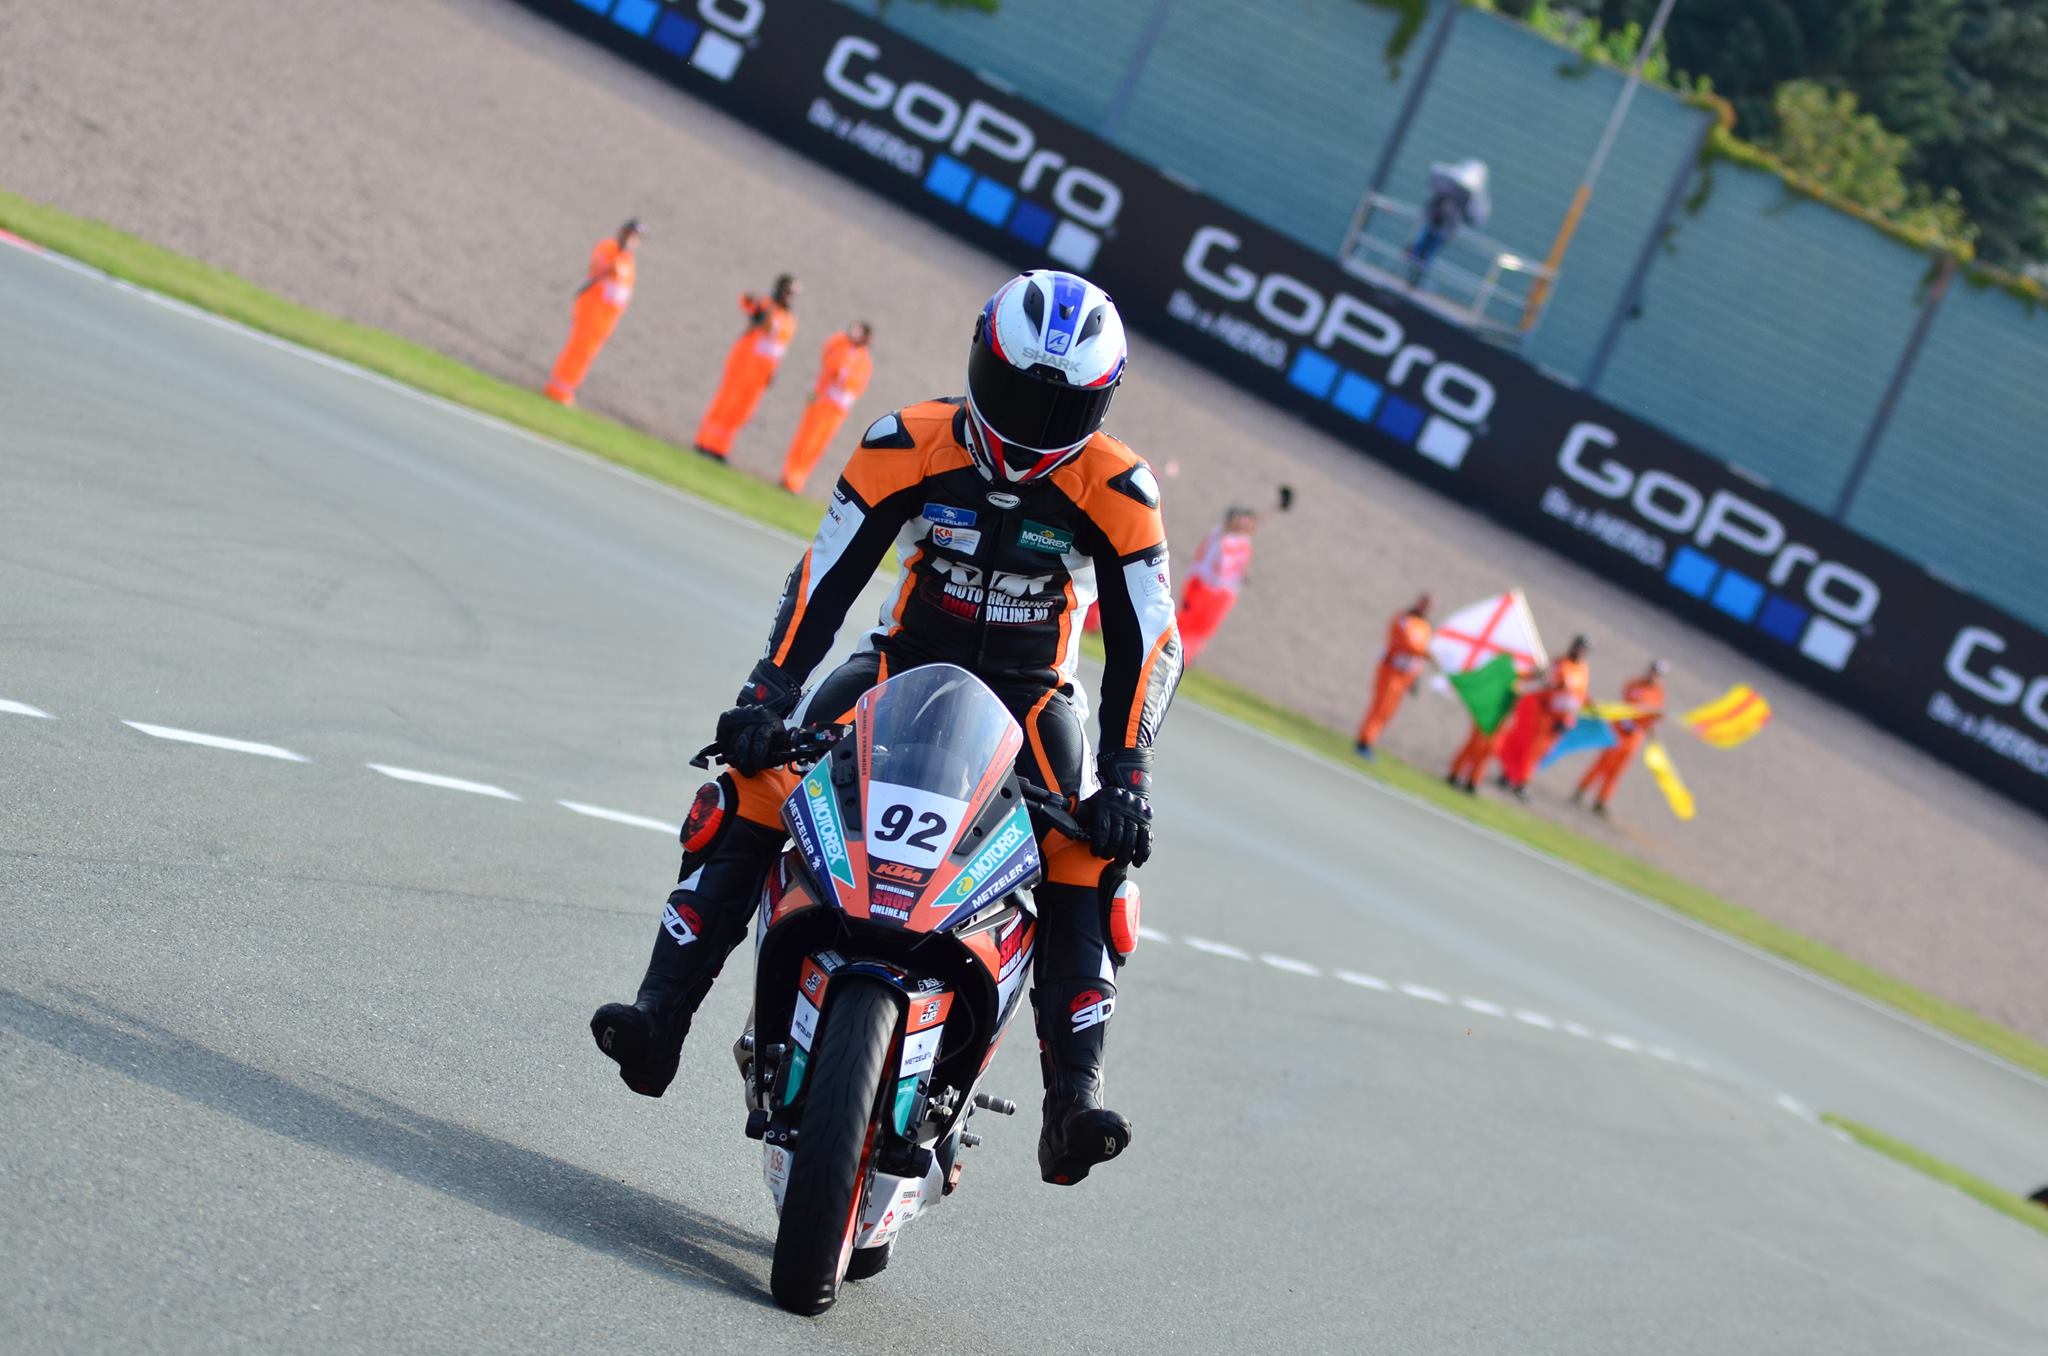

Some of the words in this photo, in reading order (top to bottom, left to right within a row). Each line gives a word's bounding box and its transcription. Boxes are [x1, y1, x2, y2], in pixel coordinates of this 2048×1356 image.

[823, 36, 1123, 229] GoPro
[1183, 225, 1497, 425] GoPro
[1022, 346, 1082, 373] SHARK
[1022, 530, 1069, 549] MOTOREX
[1557, 421, 1881, 627] GoPro
[787, 798, 815, 856] METZELER
[811, 795, 846, 866] MOTOREX
[874, 804, 948, 853] 92
[970, 823, 1024, 882] MOTOREX
[875, 862, 923, 882] KTM
[971, 865, 1023, 909] METZELER
